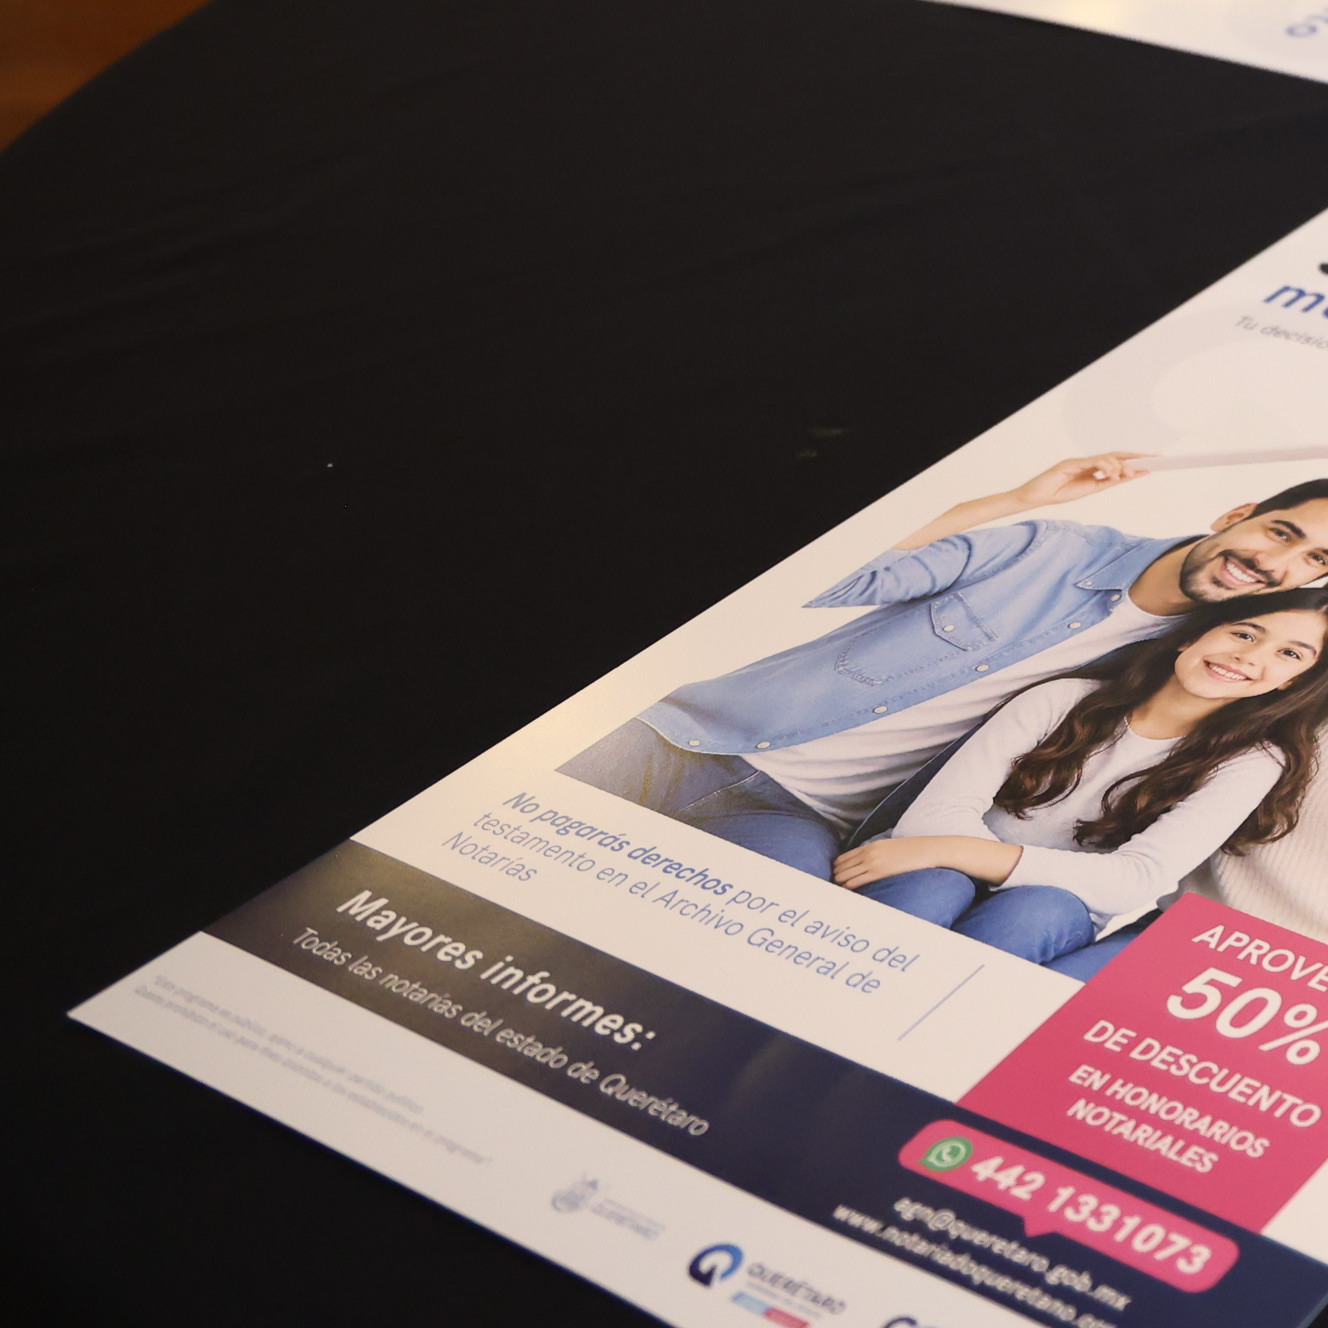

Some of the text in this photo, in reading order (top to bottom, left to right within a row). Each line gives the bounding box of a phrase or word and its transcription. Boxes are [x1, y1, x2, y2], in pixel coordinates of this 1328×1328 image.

[1233, 315, 1257, 332] Tu
[441, 831, 538, 883] Notarías
[473, 811, 882, 996] testamento en el Archivo General de
[502, 791, 921, 973] No pagarás derechos por el aviso del
[336, 889, 484, 972] Mayores
[481, 954, 657, 1052] informes:
[292, 926, 710, 1138] Todas las notarías del estado de Querétaro
[1082, 1019, 1322, 1129] DE DESCUENTO
[1066, 1098, 1220, 1174] NOTARIALES
[1068, 1064, 1272, 1160] EN HONORARIOS
[971, 1156, 1213, 1275] 442 1331073
